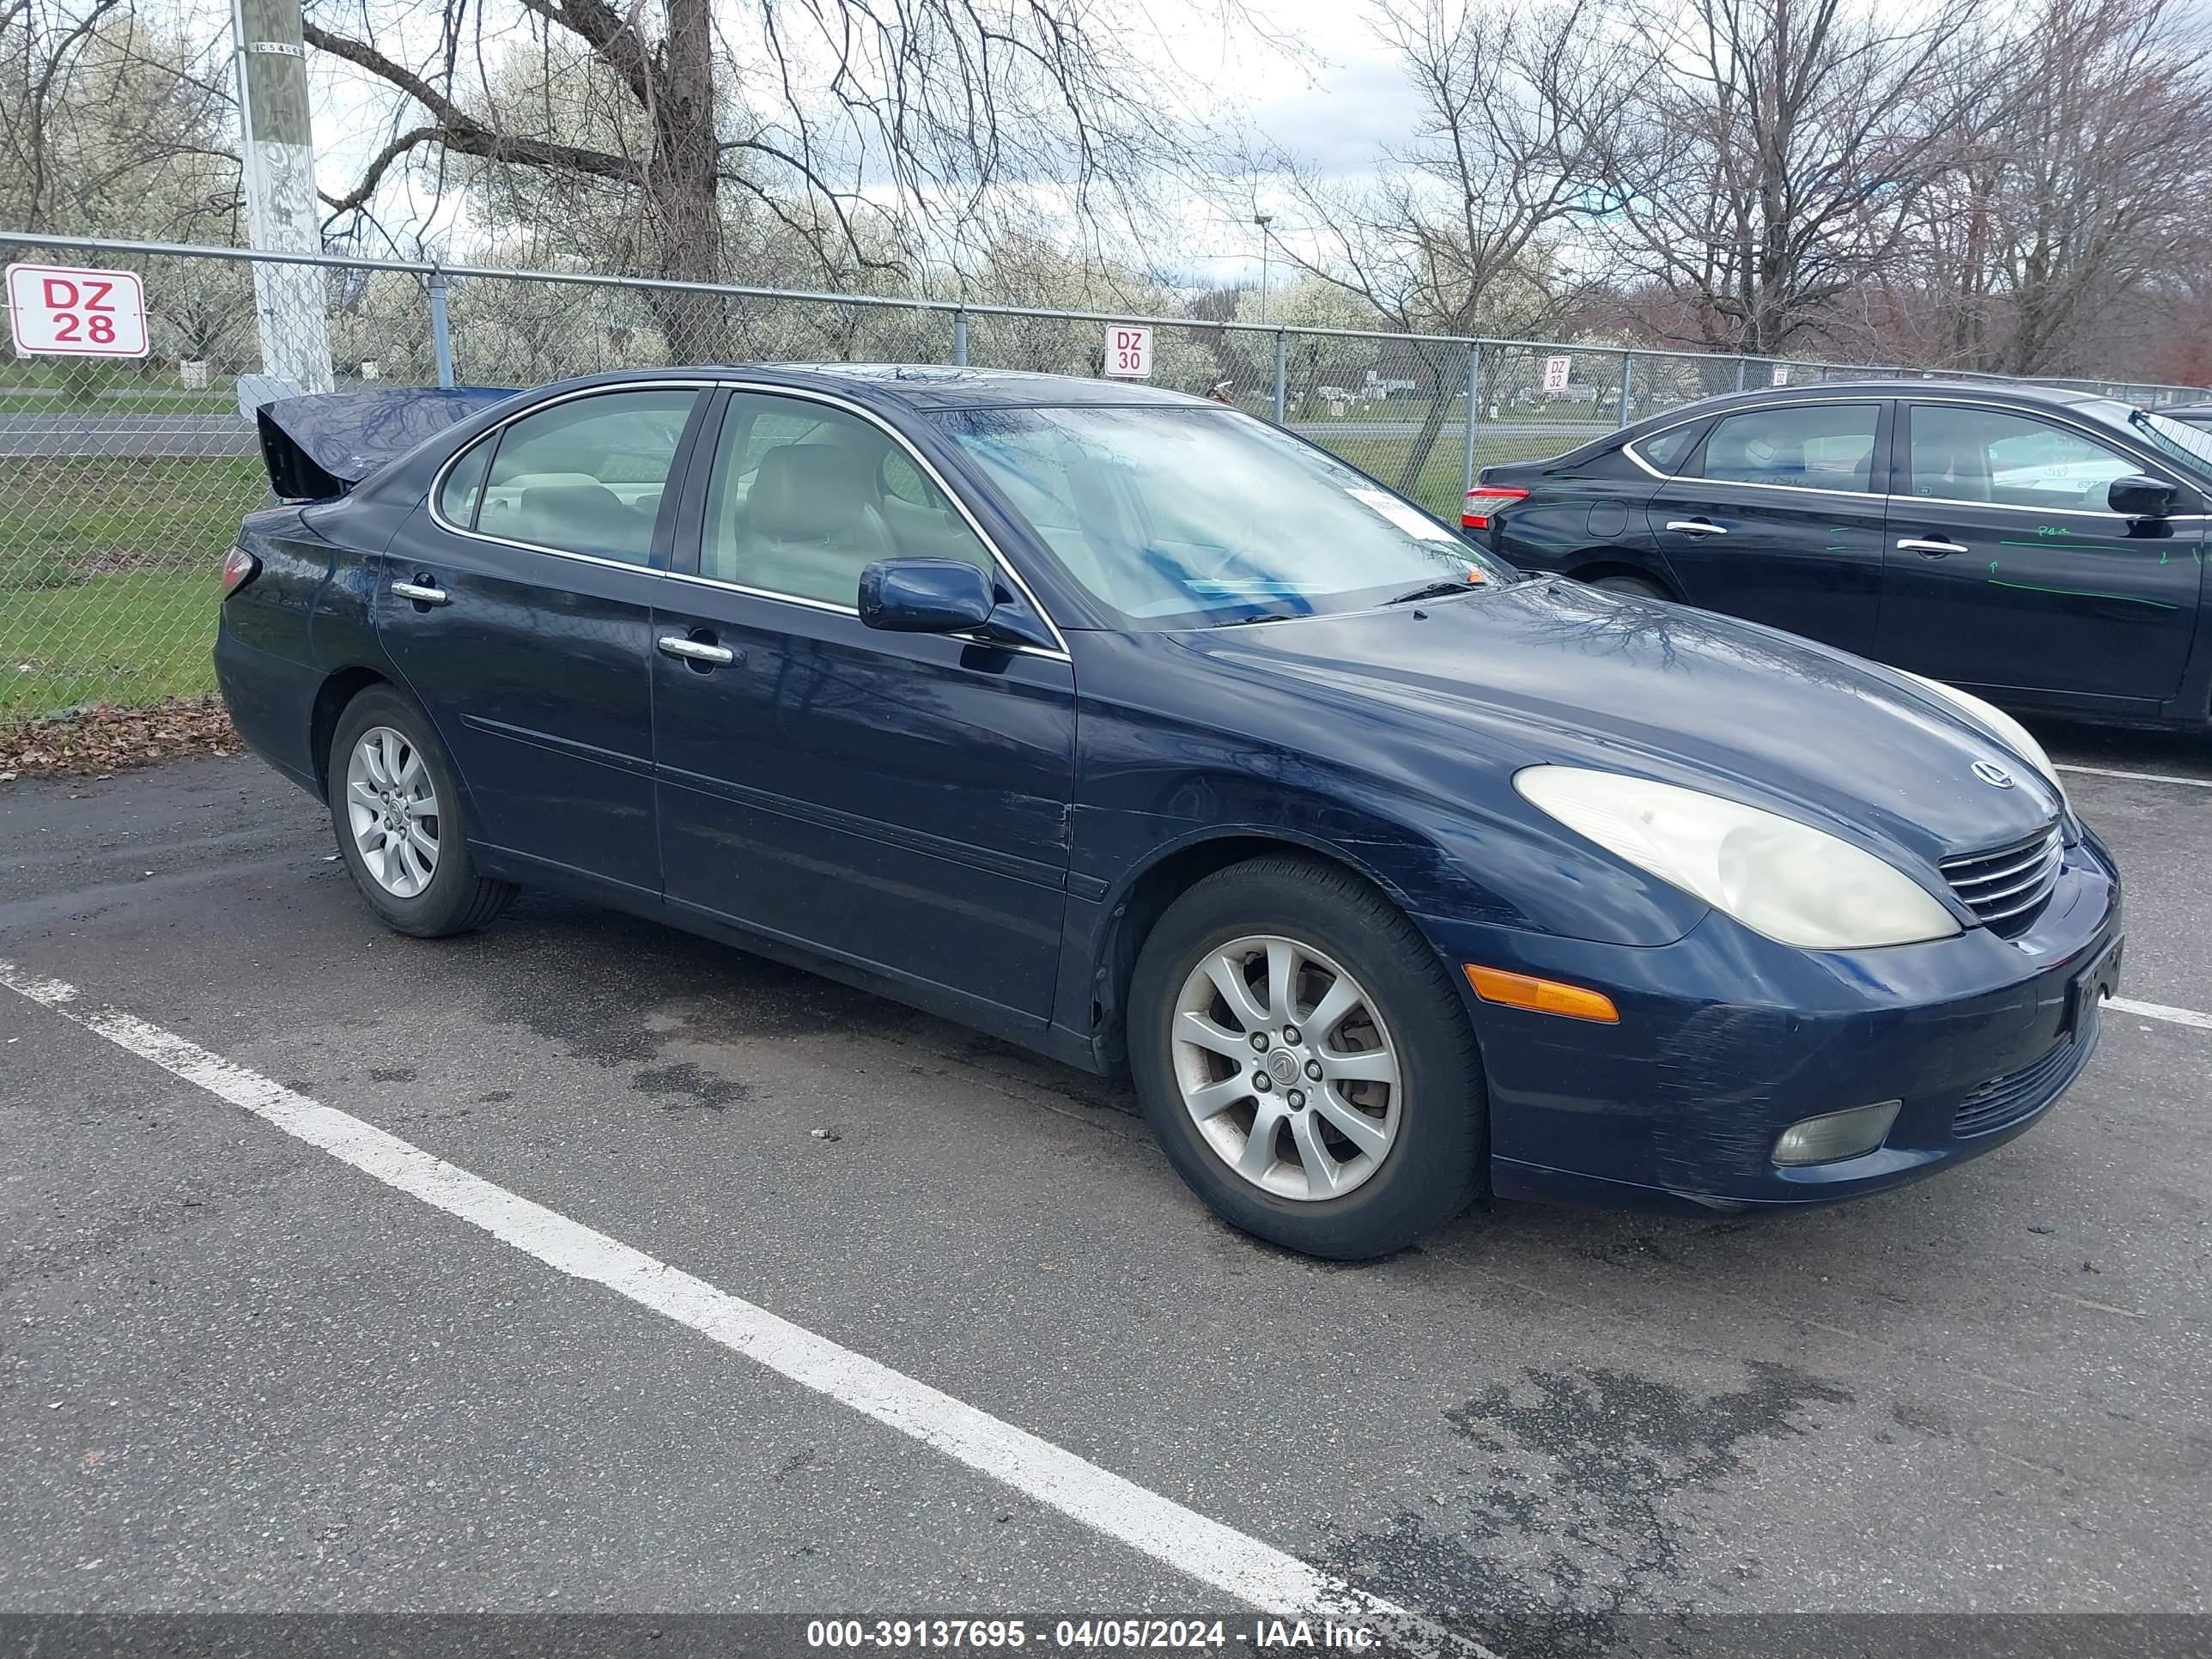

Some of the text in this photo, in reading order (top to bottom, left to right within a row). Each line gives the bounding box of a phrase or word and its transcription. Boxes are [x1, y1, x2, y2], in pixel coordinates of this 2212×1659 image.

[43, 278, 115, 312] DZ
[52, 313, 116, 343] 28
[1118, 331, 1141, 350] DZ
[1119, 352, 1140, 369] 30
[1551, 361, 1565, 373] DZ
[1550, 375, 1561, 386] 32
